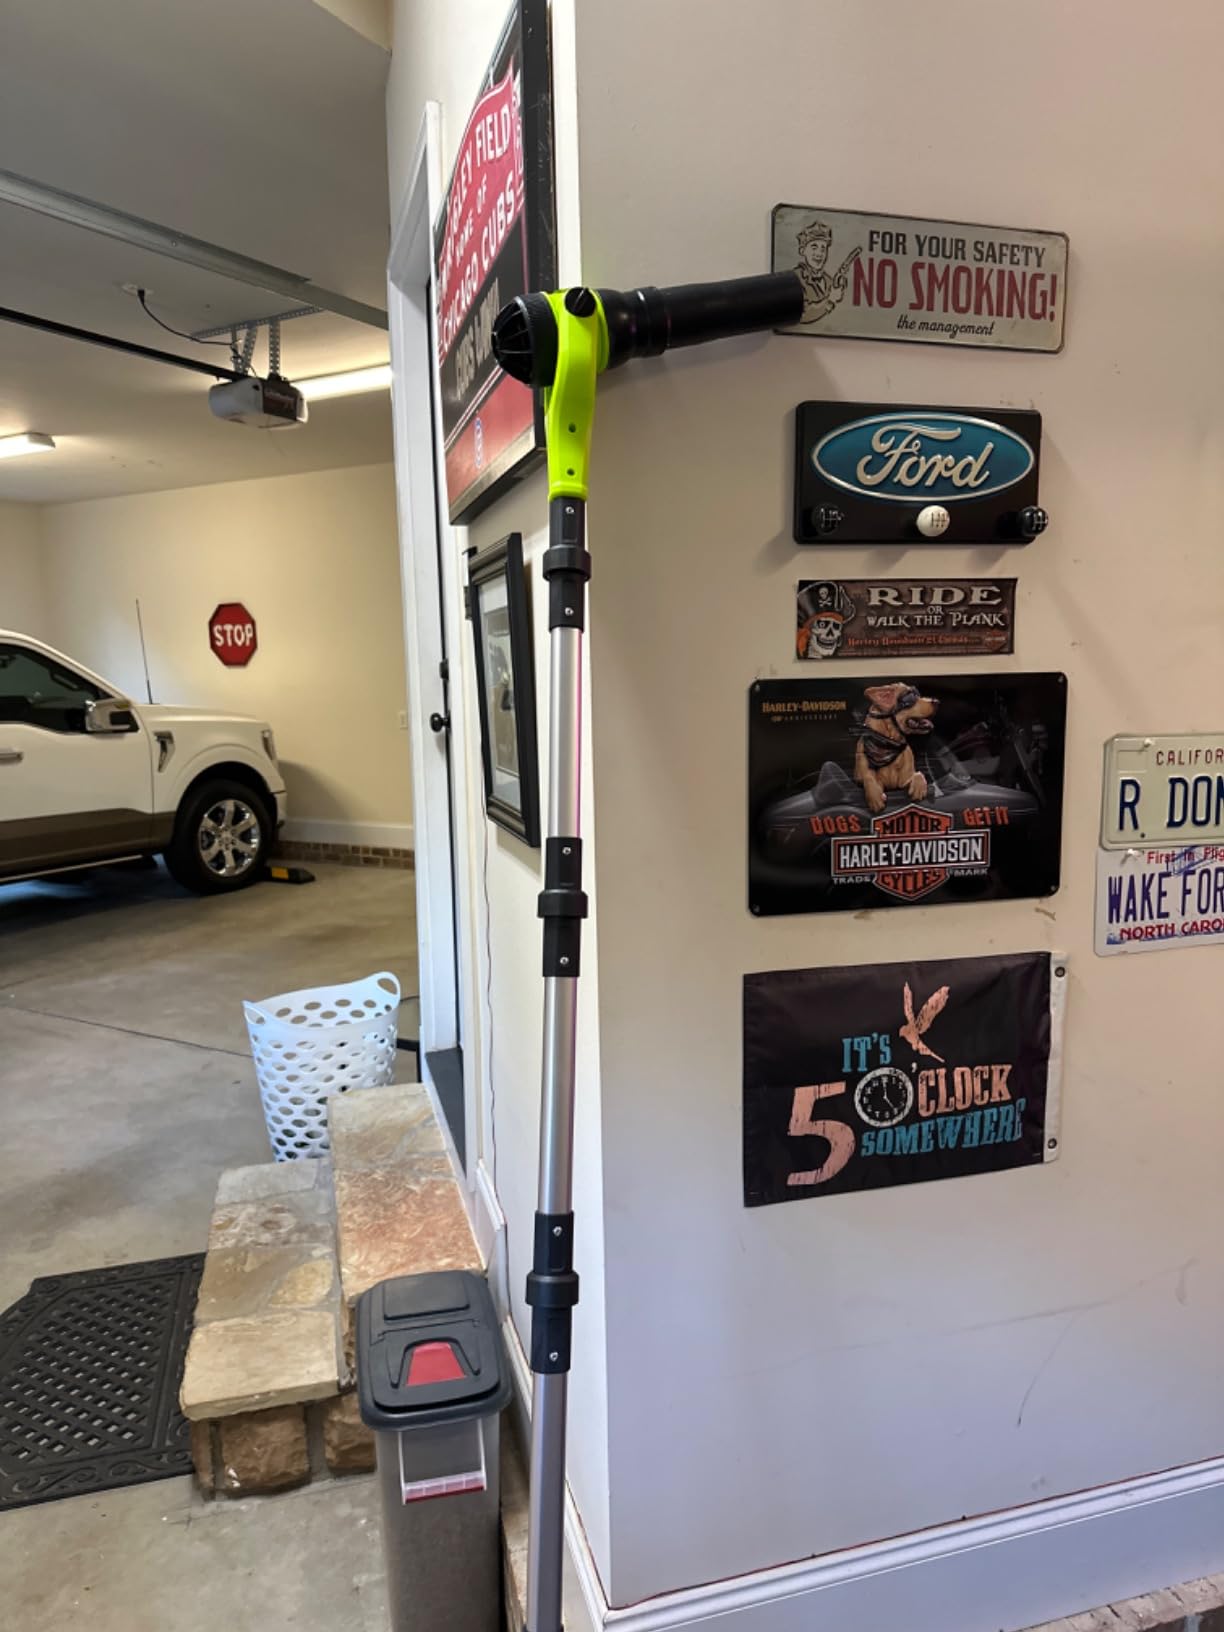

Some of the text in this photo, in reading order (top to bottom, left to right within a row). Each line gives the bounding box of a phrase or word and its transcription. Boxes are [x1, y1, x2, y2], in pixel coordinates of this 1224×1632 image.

[475, 103, 511, 168] FIELD
[476, 173, 487, 215] OF
[443, 171, 515, 352] CHICAGO CUBS
[869, 230, 1046, 268] FOR YOUR SAFETY
[852, 257, 1057, 322] NO SMOKING!
[897, 314, 995, 339] the management
[856, 422, 994, 488] Ford
[867, 586, 1002, 606] RIDE
[867, 612, 1005, 628] WALK THE PLANK
[927, 605, 944, 615] OR
[213, 623, 254, 647] STOP
[762, 700, 847, 713] HARLEY-DAVIDSON
[962, 806, 1010, 827] GET IT
[1118, 778, 1141, 831] R
[809, 816, 862, 836] DOGS
[882, 812, 942, 836] MOTOR
[839, 837, 983, 869] HARLEY-DAVIDSON
[1146, 850, 1176, 865] First
[832, 875, 871, 885] TRADE
[880, 870, 942, 895] CYCLES
[953, 868, 989, 877] MARK
[1108, 871, 1172, 924] WAKE
[1119, 918, 1224, 941] NORTH CARO
[842, 1032, 892, 1072] IT'S
[787, 1081, 856, 1186] 5
